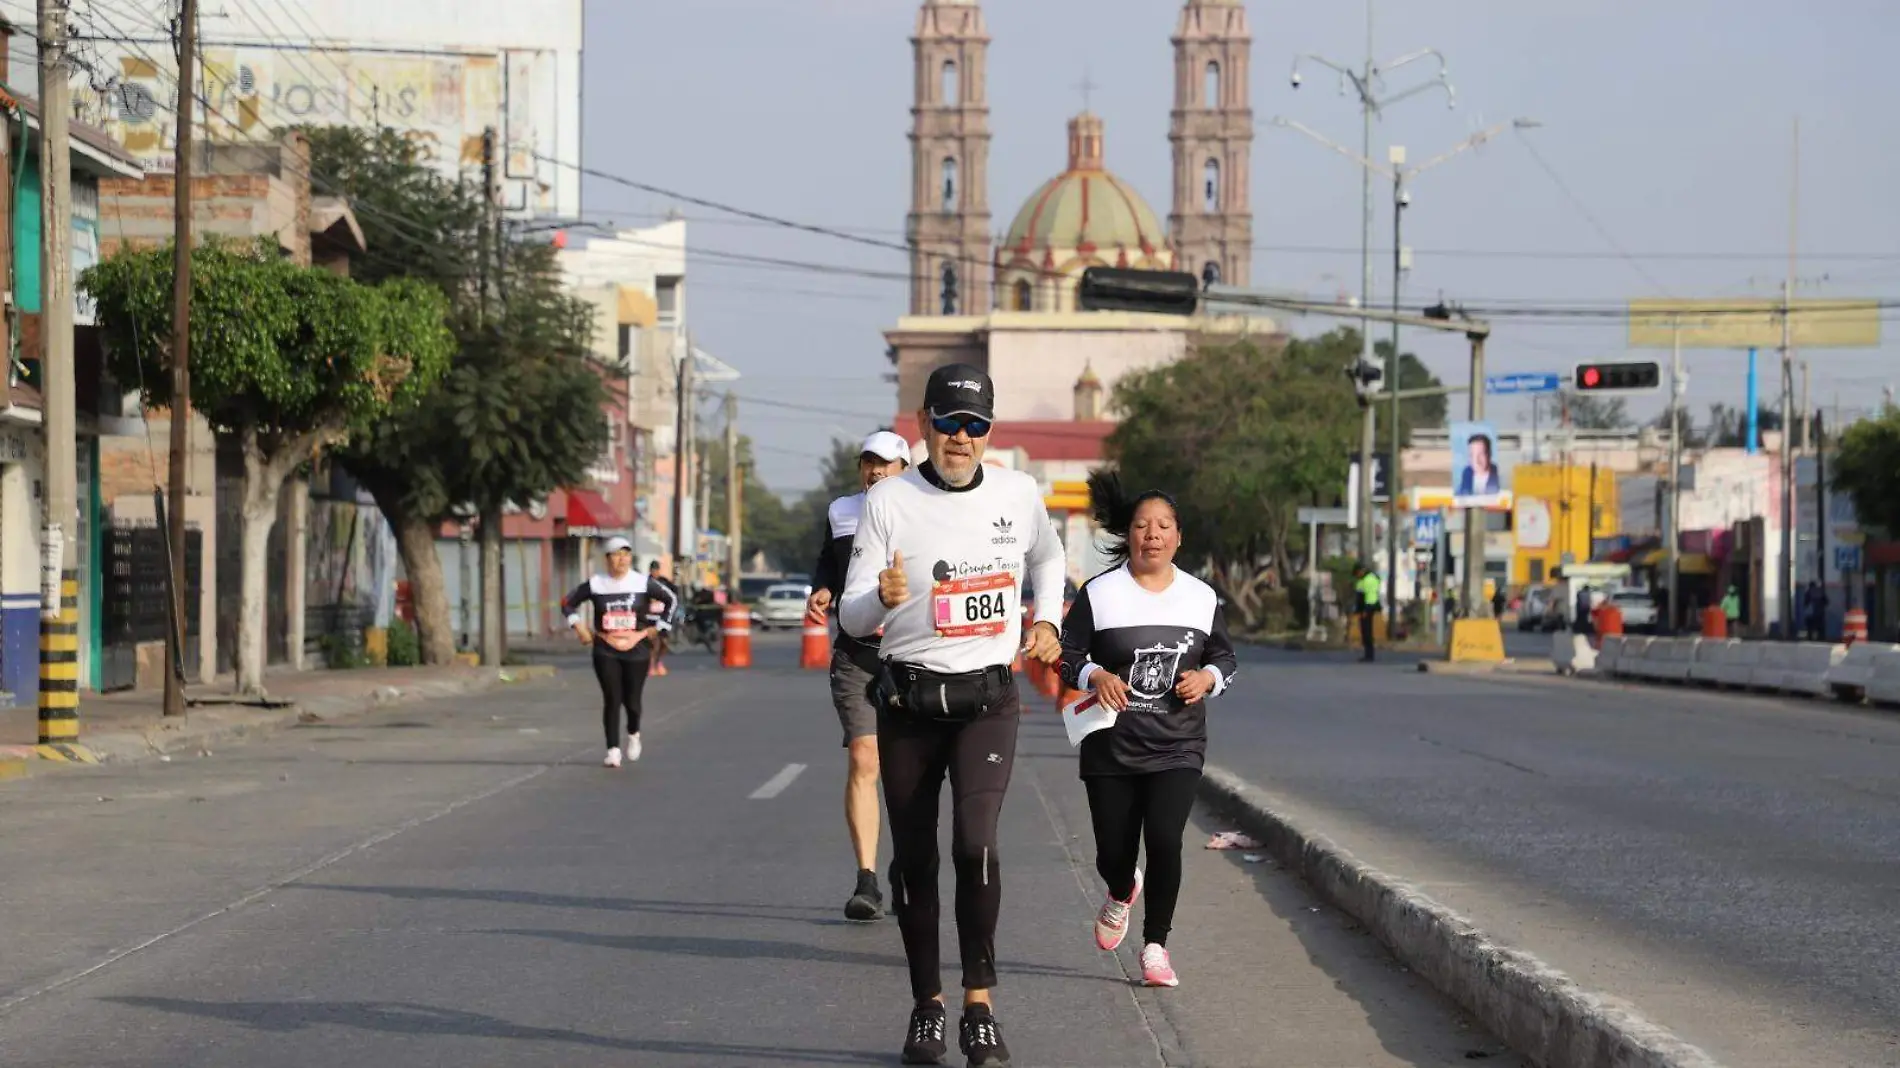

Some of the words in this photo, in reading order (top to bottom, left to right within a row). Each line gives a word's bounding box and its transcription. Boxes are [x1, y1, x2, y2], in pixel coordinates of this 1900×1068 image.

[991, 536, 1017, 545] adidas
[959, 560, 993, 575] Grupo
[965, 592, 1006, 622] 684
